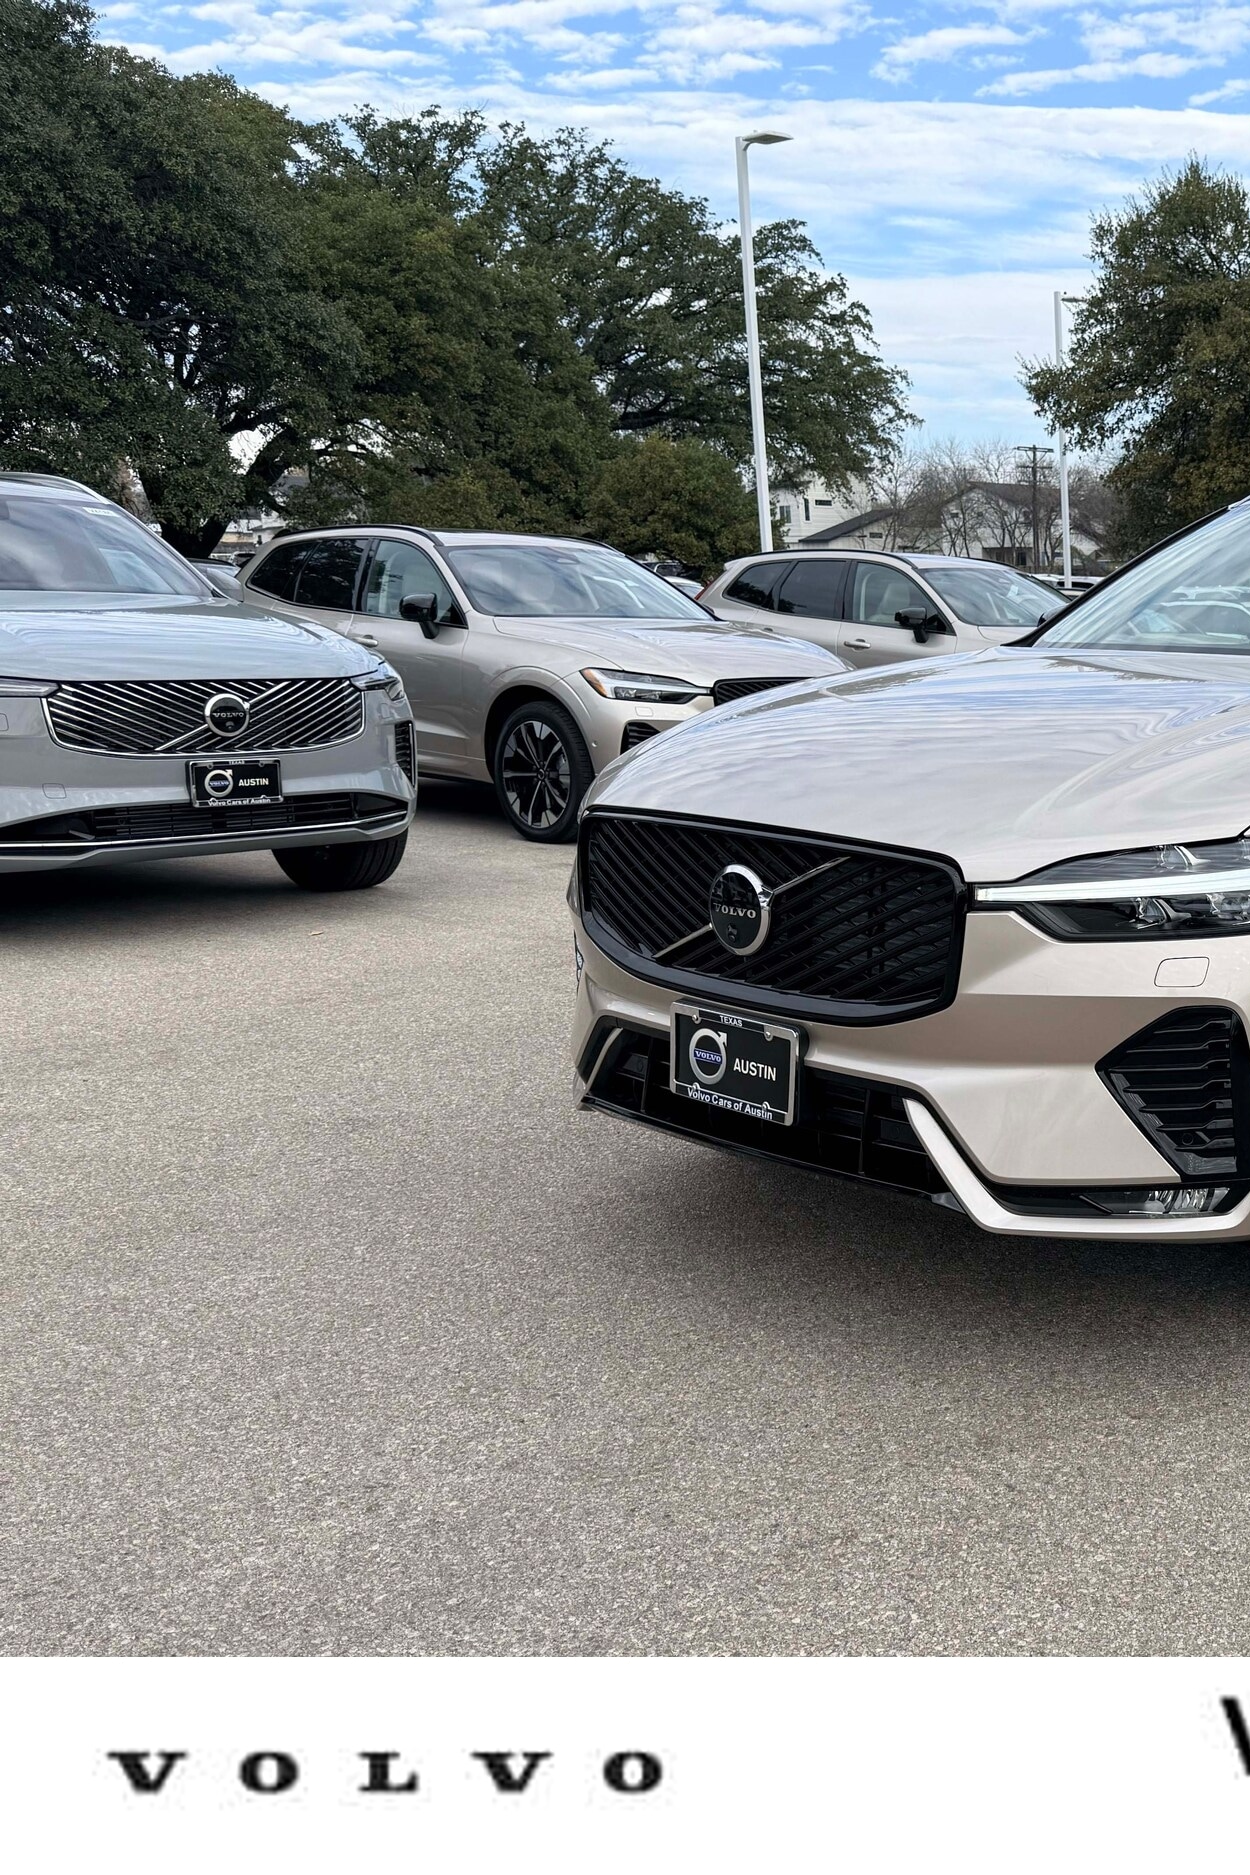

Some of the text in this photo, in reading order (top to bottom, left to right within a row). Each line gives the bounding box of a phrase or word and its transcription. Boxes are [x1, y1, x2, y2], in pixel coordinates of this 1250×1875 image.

[238, 778, 269, 787] AUSTIN
[226, 798, 242, 806] Cars
[713, 902, 757, 919] VOLVO
[719, 1015, 743, 1027] TEXAS
[694, 1050, 722, 1063] VOLVO
[733, 1057, 777, 1082] AUSTIN
[687, 1087, 773, 1121] Volvo Cars of Austin
